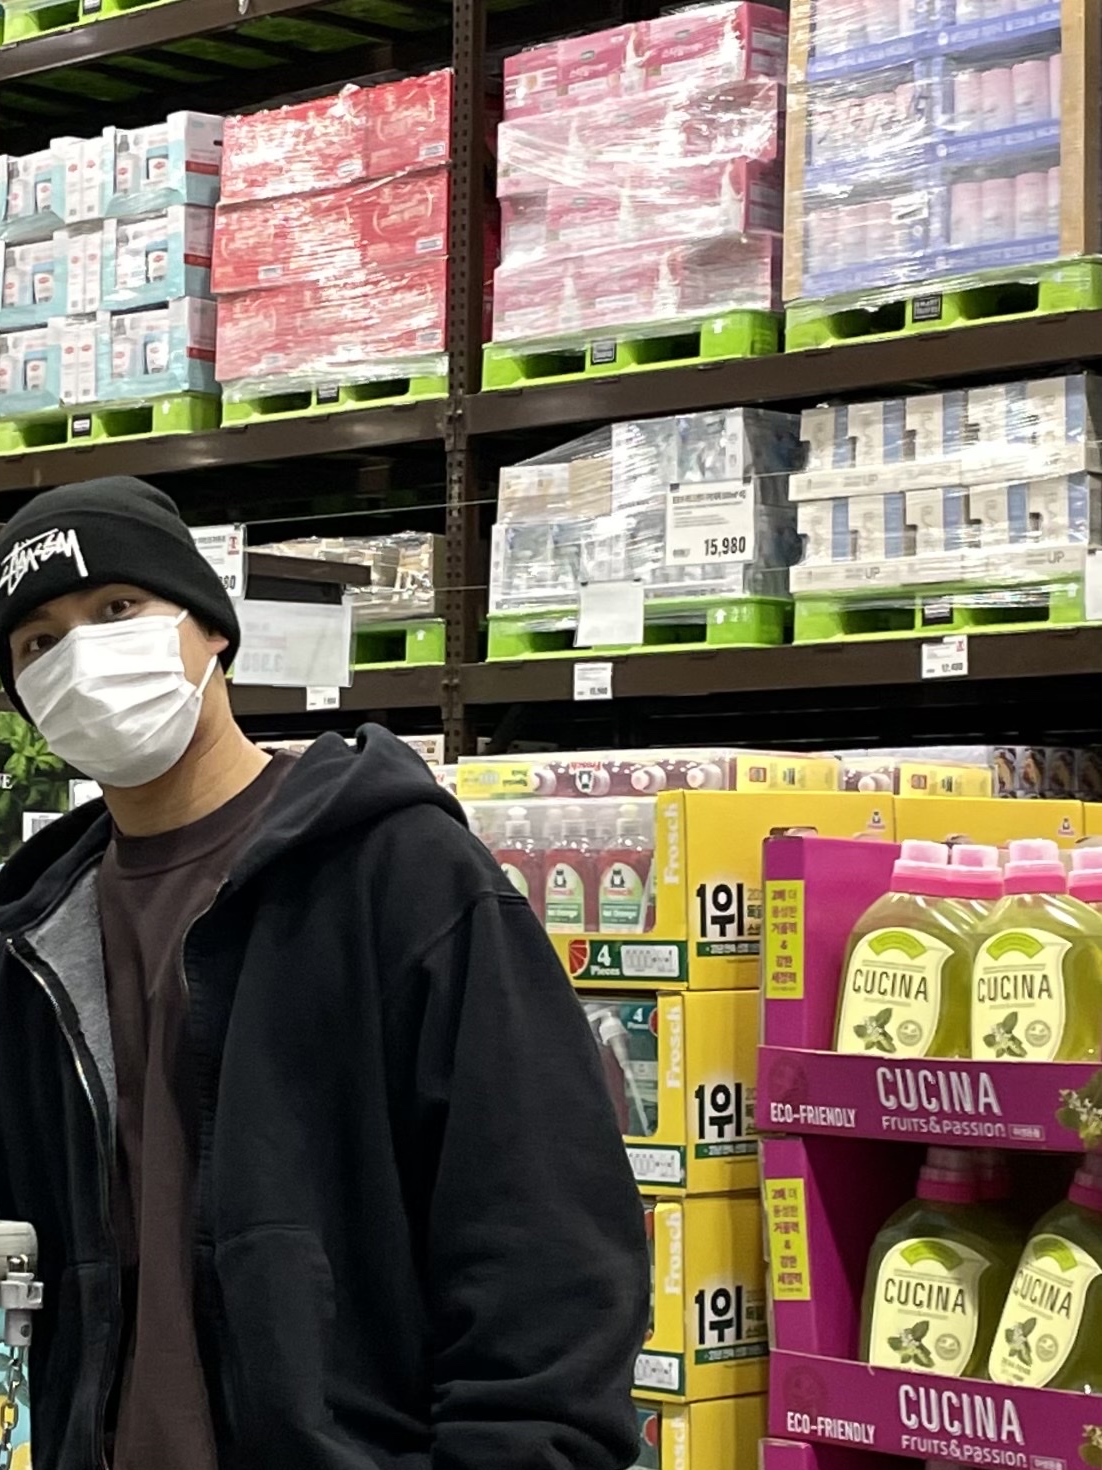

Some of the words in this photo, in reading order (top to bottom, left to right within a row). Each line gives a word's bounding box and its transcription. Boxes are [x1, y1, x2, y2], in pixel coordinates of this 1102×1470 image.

[704, 536, 746, 558] 15,980
[1048, 551, 1064, 564] UP
[865, 566, 880, 580] UP
[664, 802, 680, 885] Frosch
[696, 883, 744, 938] 1위
[591, 965, 620, 977] Pieces
[598, 944, 611, 967] 4
[852, 968, 929, 1002] CUCINA
[977, 974, 1053, 1004] CUCINA
[633, 1008, 644, 1022] 4
[876, 1067, 1003, 1116] CUCINA
[695, 1082, 742, 1139] 1위
[770, 1102, 856, 1128] ECO-FRIENDLY
[665, 1212, 683, 1296] Frosch
[884, 1278, 967, 1316] CUCINA
[1014, 1268, 1072, 1320] CUCINA
[695, 1285, 743, 1345] 1위
[787, 1411, 876, 1445] ECO-FRIENDLY
[898, 1384, 1025, 1446] CUCINA
